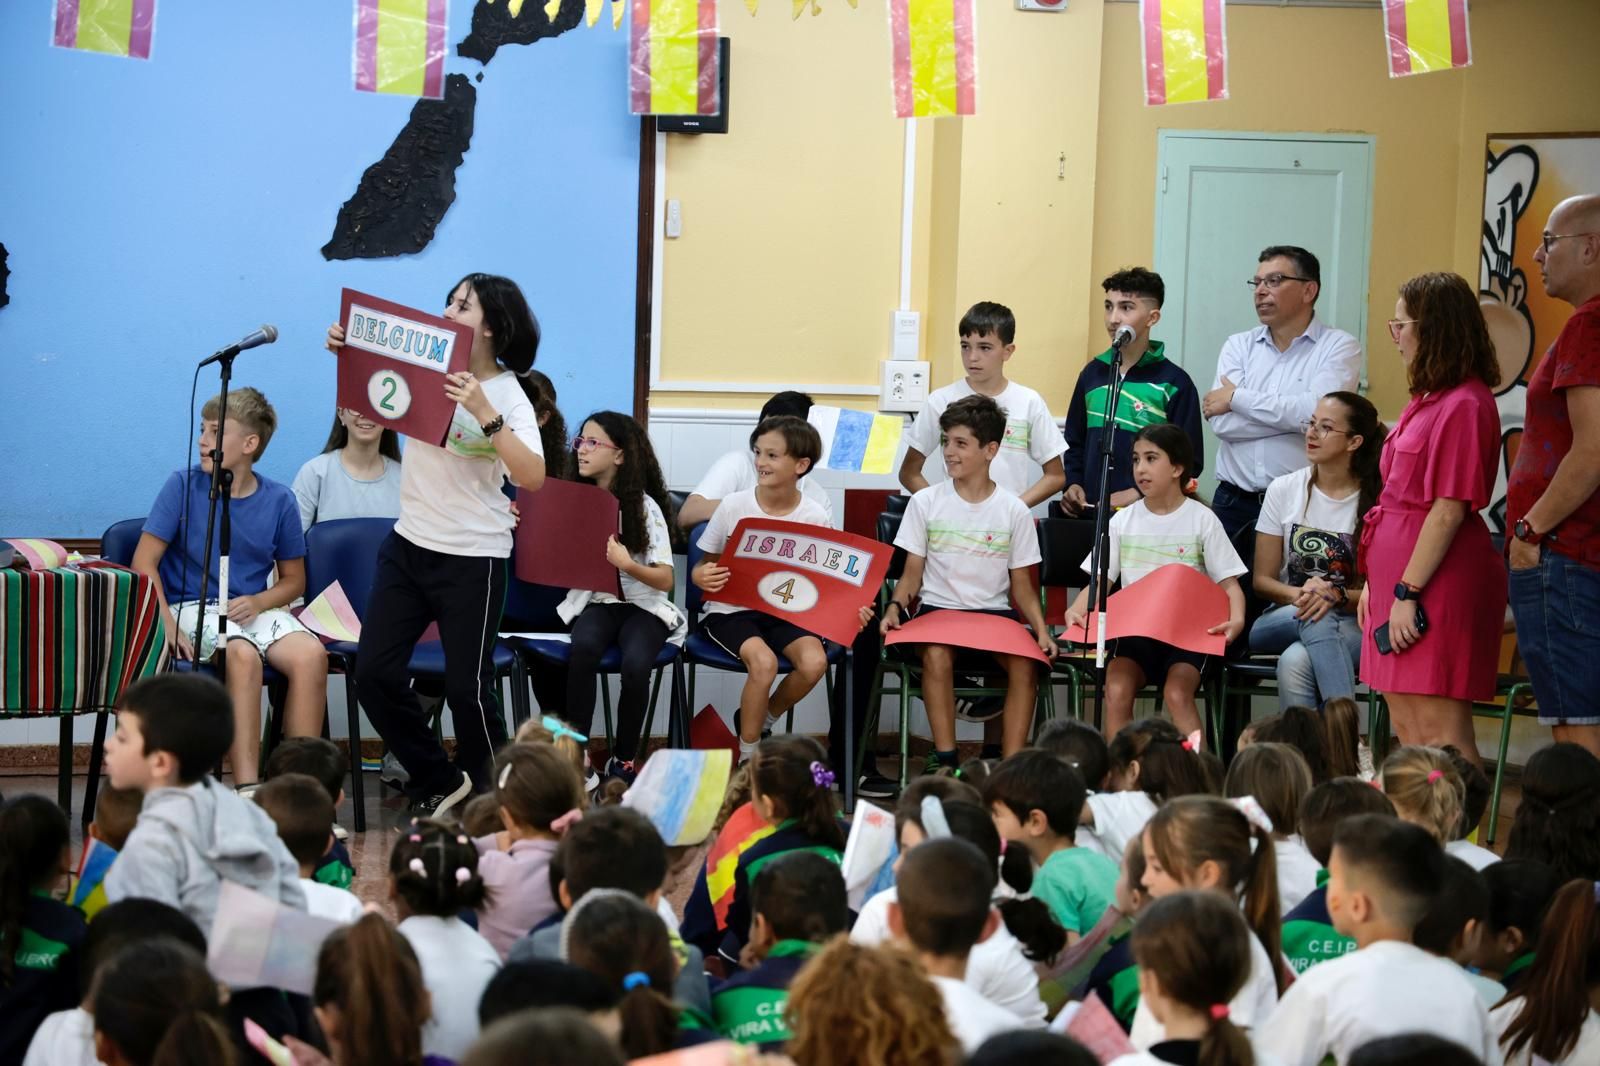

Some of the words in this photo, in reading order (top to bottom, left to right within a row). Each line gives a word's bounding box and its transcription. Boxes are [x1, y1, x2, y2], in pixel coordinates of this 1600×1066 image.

[350, 313, 449, 363] BELGIUM
[379, 376, 398, 411] 2
[743, 534, 860, 578] ISRAEL
[771, 578, 795, 605] 4
